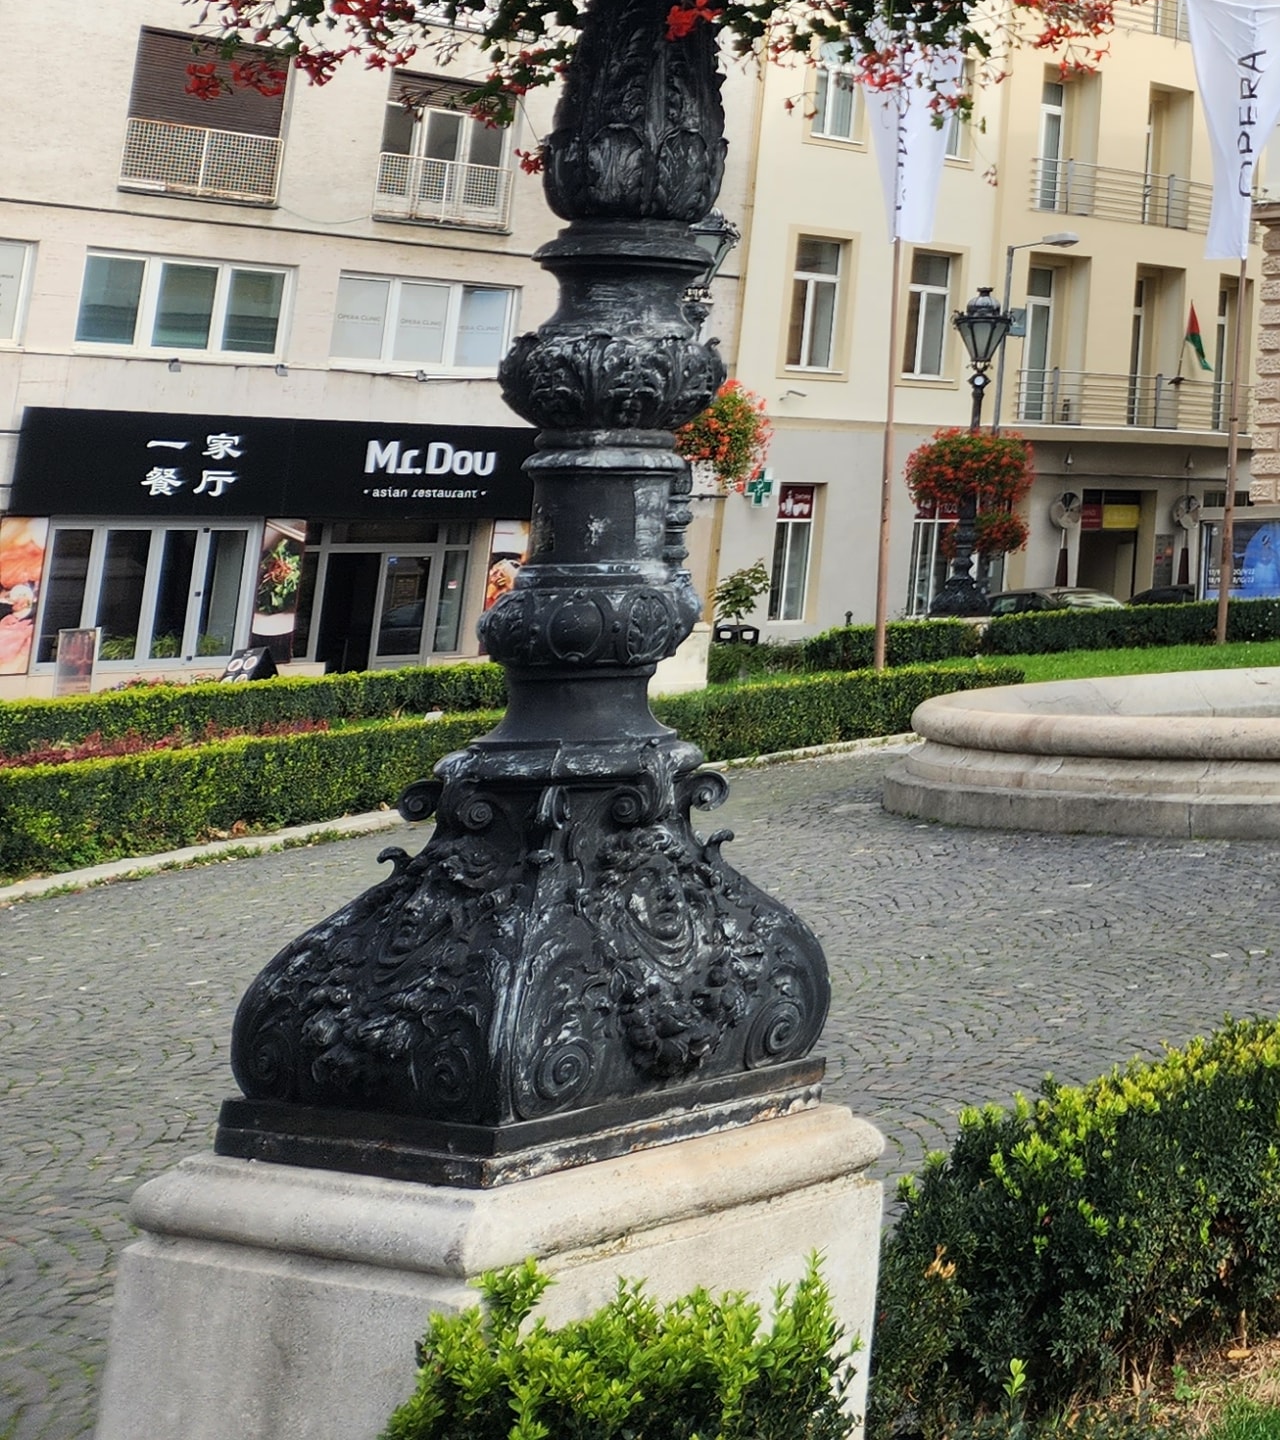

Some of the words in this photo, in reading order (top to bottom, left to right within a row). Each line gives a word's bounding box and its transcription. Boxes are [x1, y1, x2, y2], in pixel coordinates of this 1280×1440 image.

[1237, 49, 1267, 197] OPERA
[147, 433, 243, 460] 一家
[140, 466, 238, 497] 餐厅
[372, 487, 408, 498] asian
[411, 488, 478, 499] restaurant
